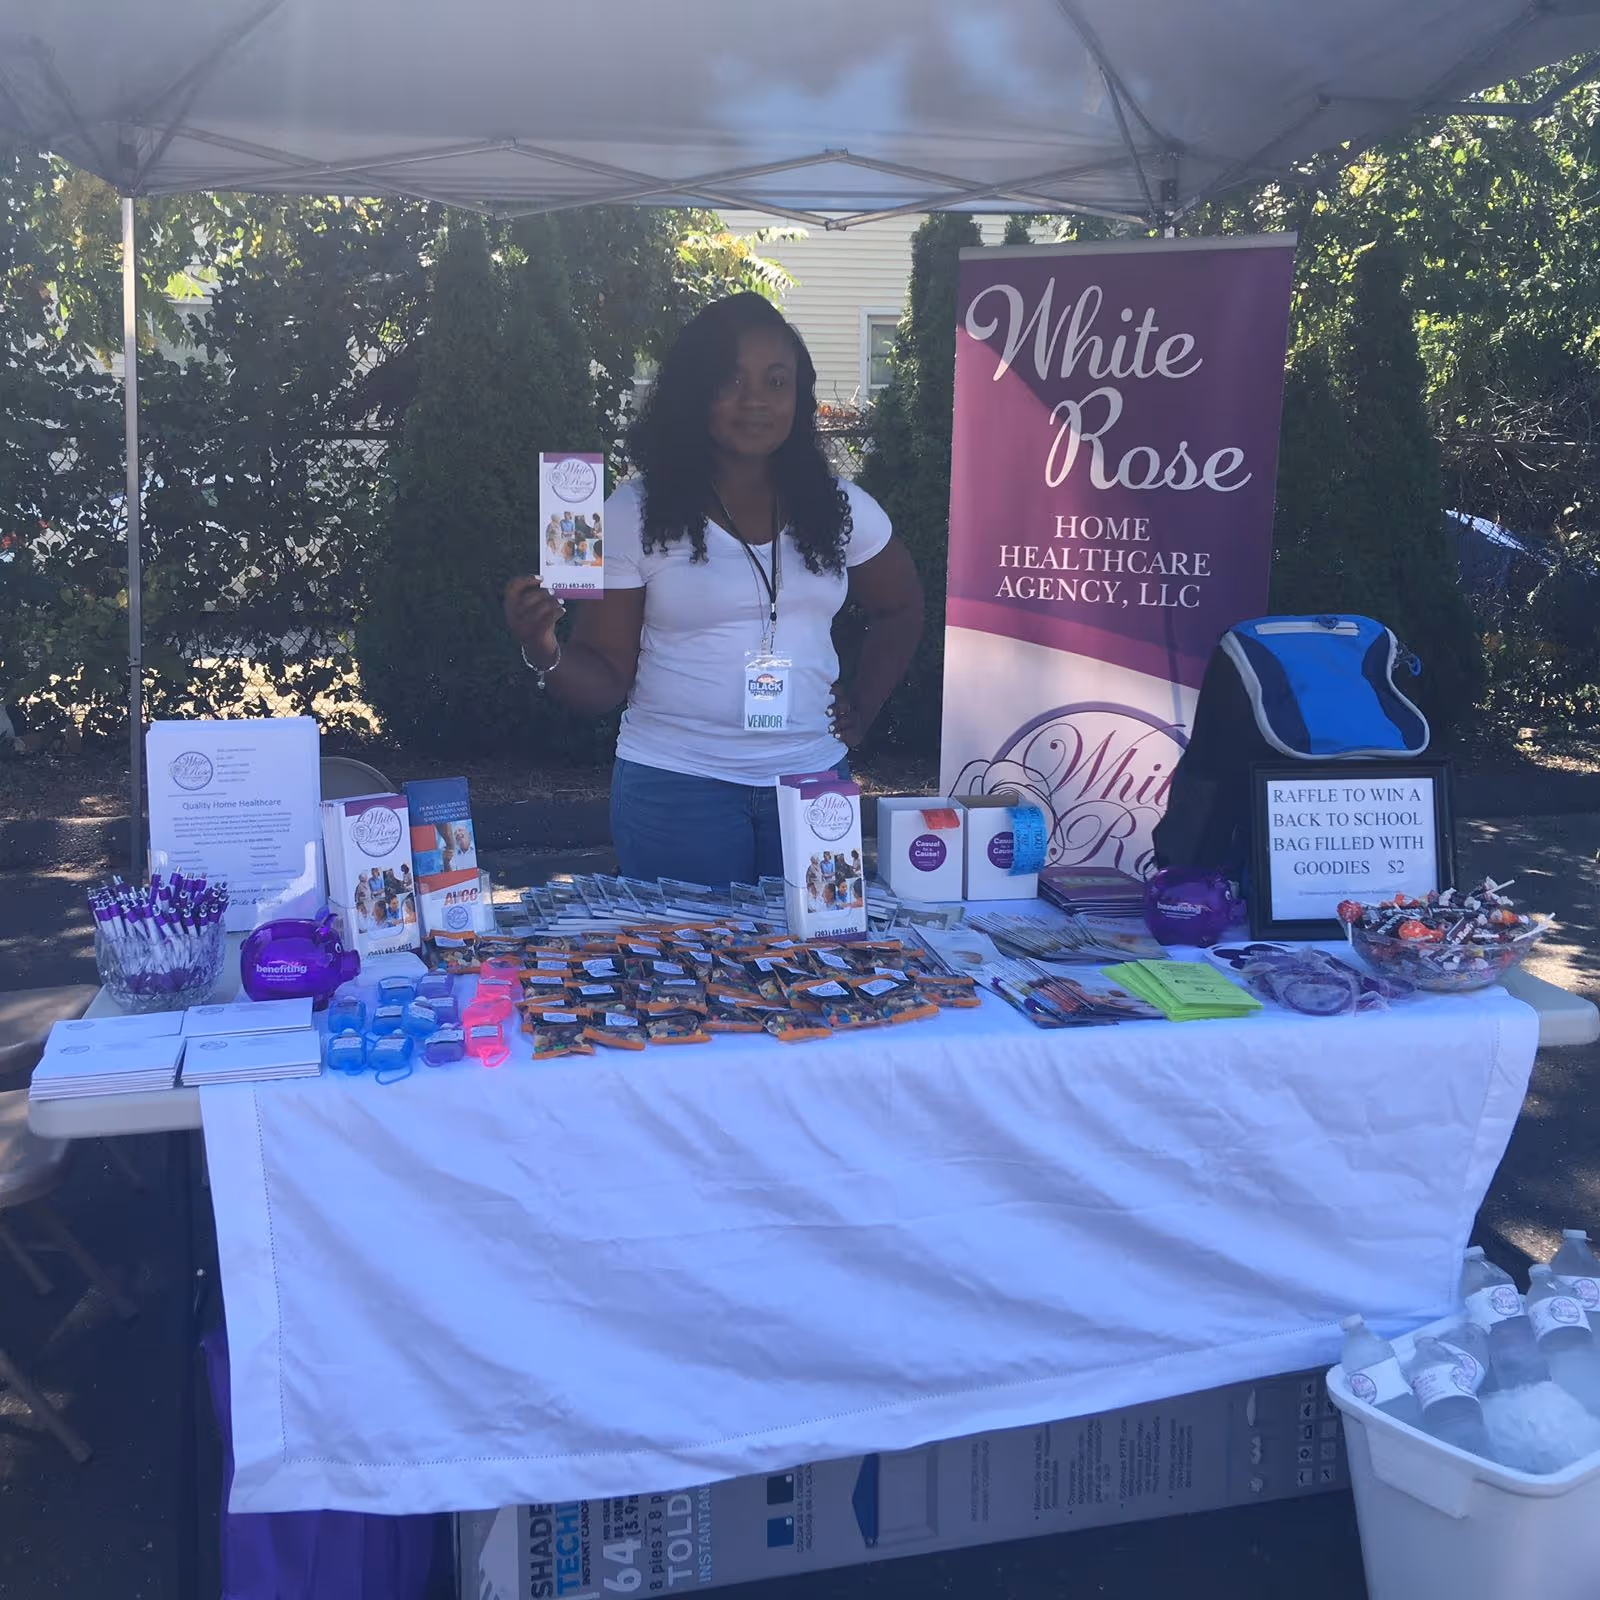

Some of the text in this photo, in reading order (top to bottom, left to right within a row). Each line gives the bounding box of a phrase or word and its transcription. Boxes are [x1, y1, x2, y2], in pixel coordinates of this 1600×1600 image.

[965, 277, 1203, 382] White
[1045, 387, 1252, 492] Rose
[1054, 515, 1151, 541] HOME
[999, 545, 1212, 577] HEALTHCARE
[995, 576, 1201, 609] AGENCY, LLC
[749, 682, 782, 692] BLACK
[747, 714, 783, 728] VENDOR
[1023, 722, 1186, 807] Whit
[1273, 788, 1422, 803] RAFFLE TO WIN A
[182, 802, 211, 810] Quality
[239, 799, 282, 807] Healthcare
[1273, 812, 1423, 827] BACK TO SCHOOL
[1273, 836, 1424, 851] BAG FILLED WITH
[1294, 860, 1370, 875] GOODIES
[1157, 902, 1202, 914] benefiting
[256, 963, 307, 974] benefiting
[648, 1511, 663, 1520] 8
[651, 1525, 663, 1535] x
[581, 1500, 591, 1586] INSTANT CANOP
[667, 1494, 692, 1587] TOLD
[529, 1504, 554, 1599] SHADE
[648, 1540, 665, 1574] pies
[603, 1539, 641, 1592] 64
[649, 1581, 663, 1590] 8
